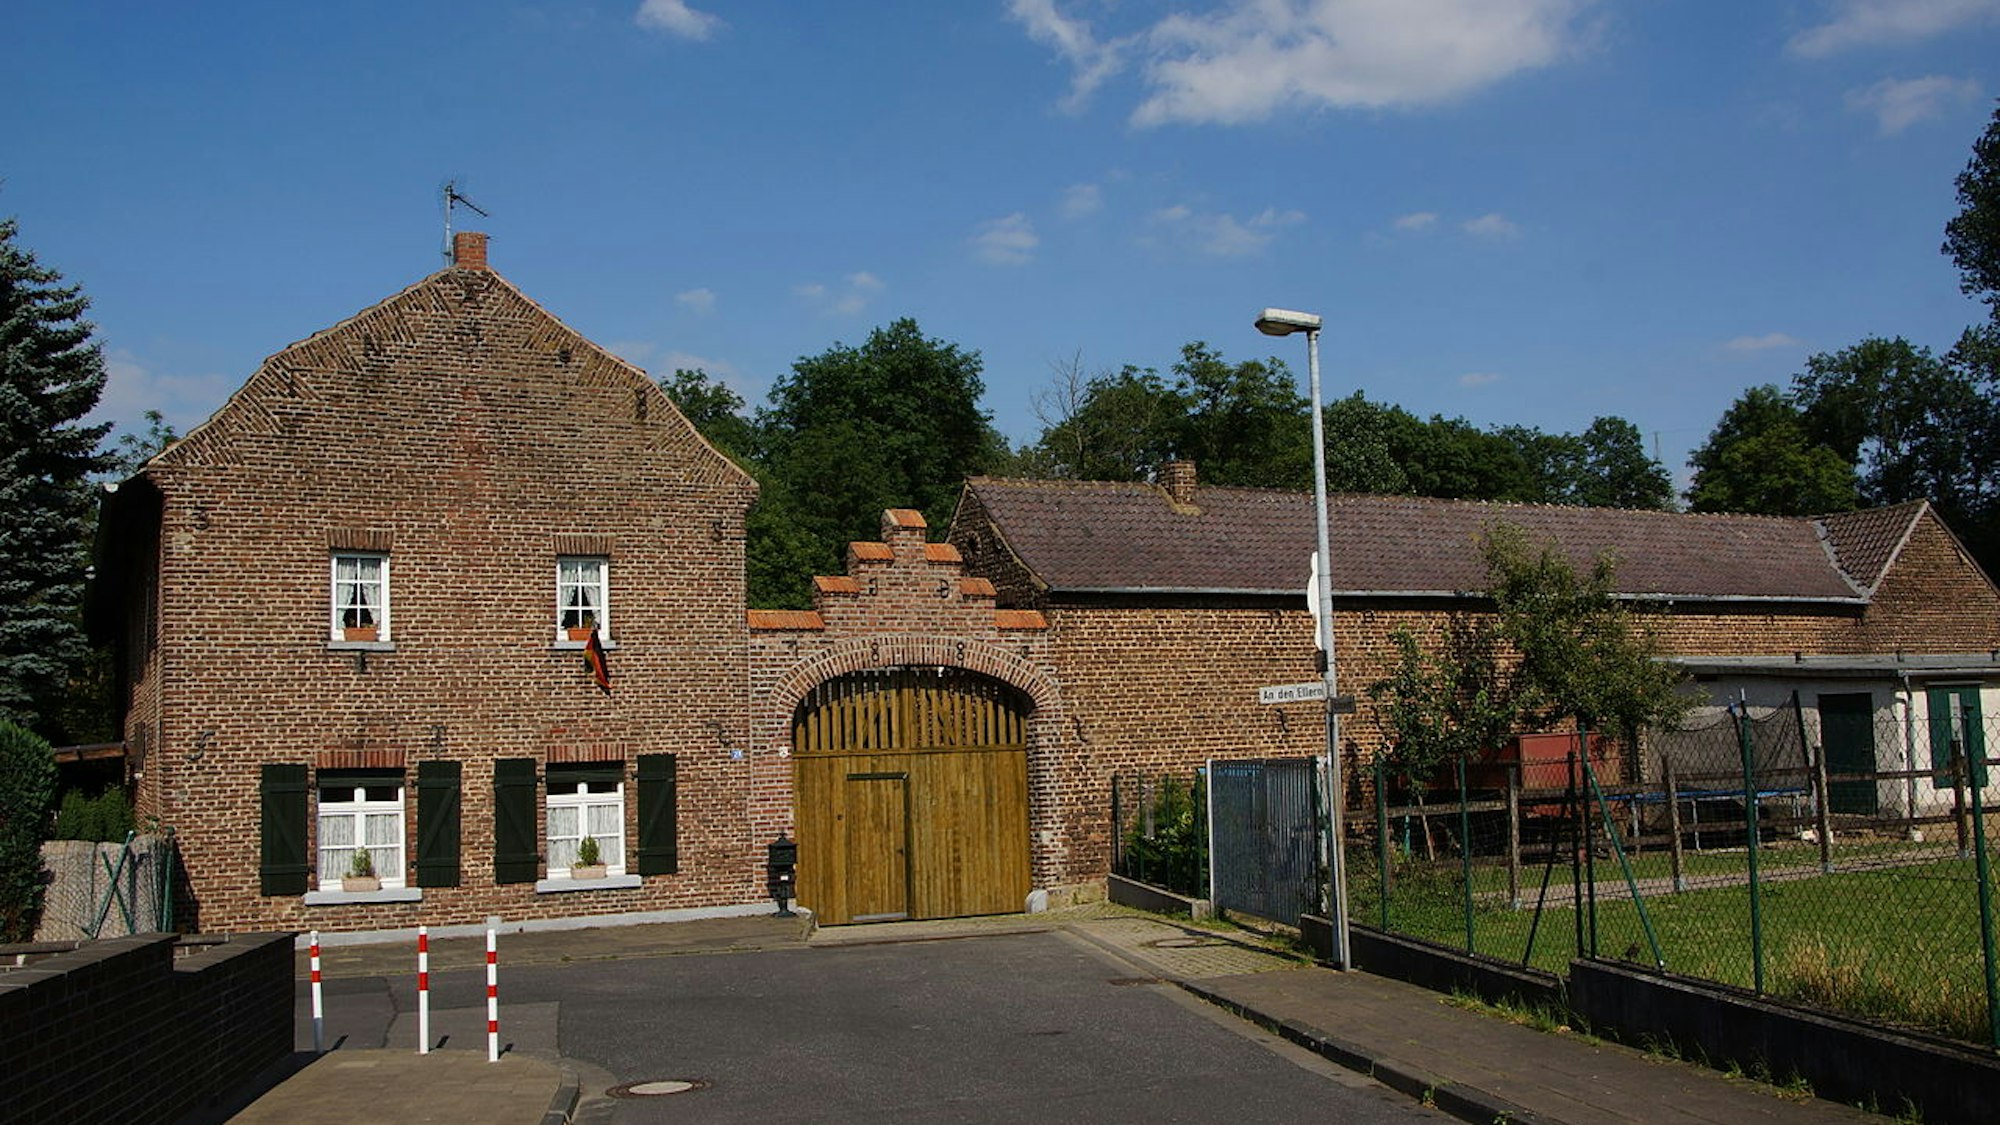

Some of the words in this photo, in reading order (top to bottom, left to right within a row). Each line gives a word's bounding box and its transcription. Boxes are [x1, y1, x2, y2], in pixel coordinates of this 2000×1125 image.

[1263, 690, 1274, 700] An
[1278, 688, 1294, 700] den
[1297, 686, 1323, 698] Ellern
